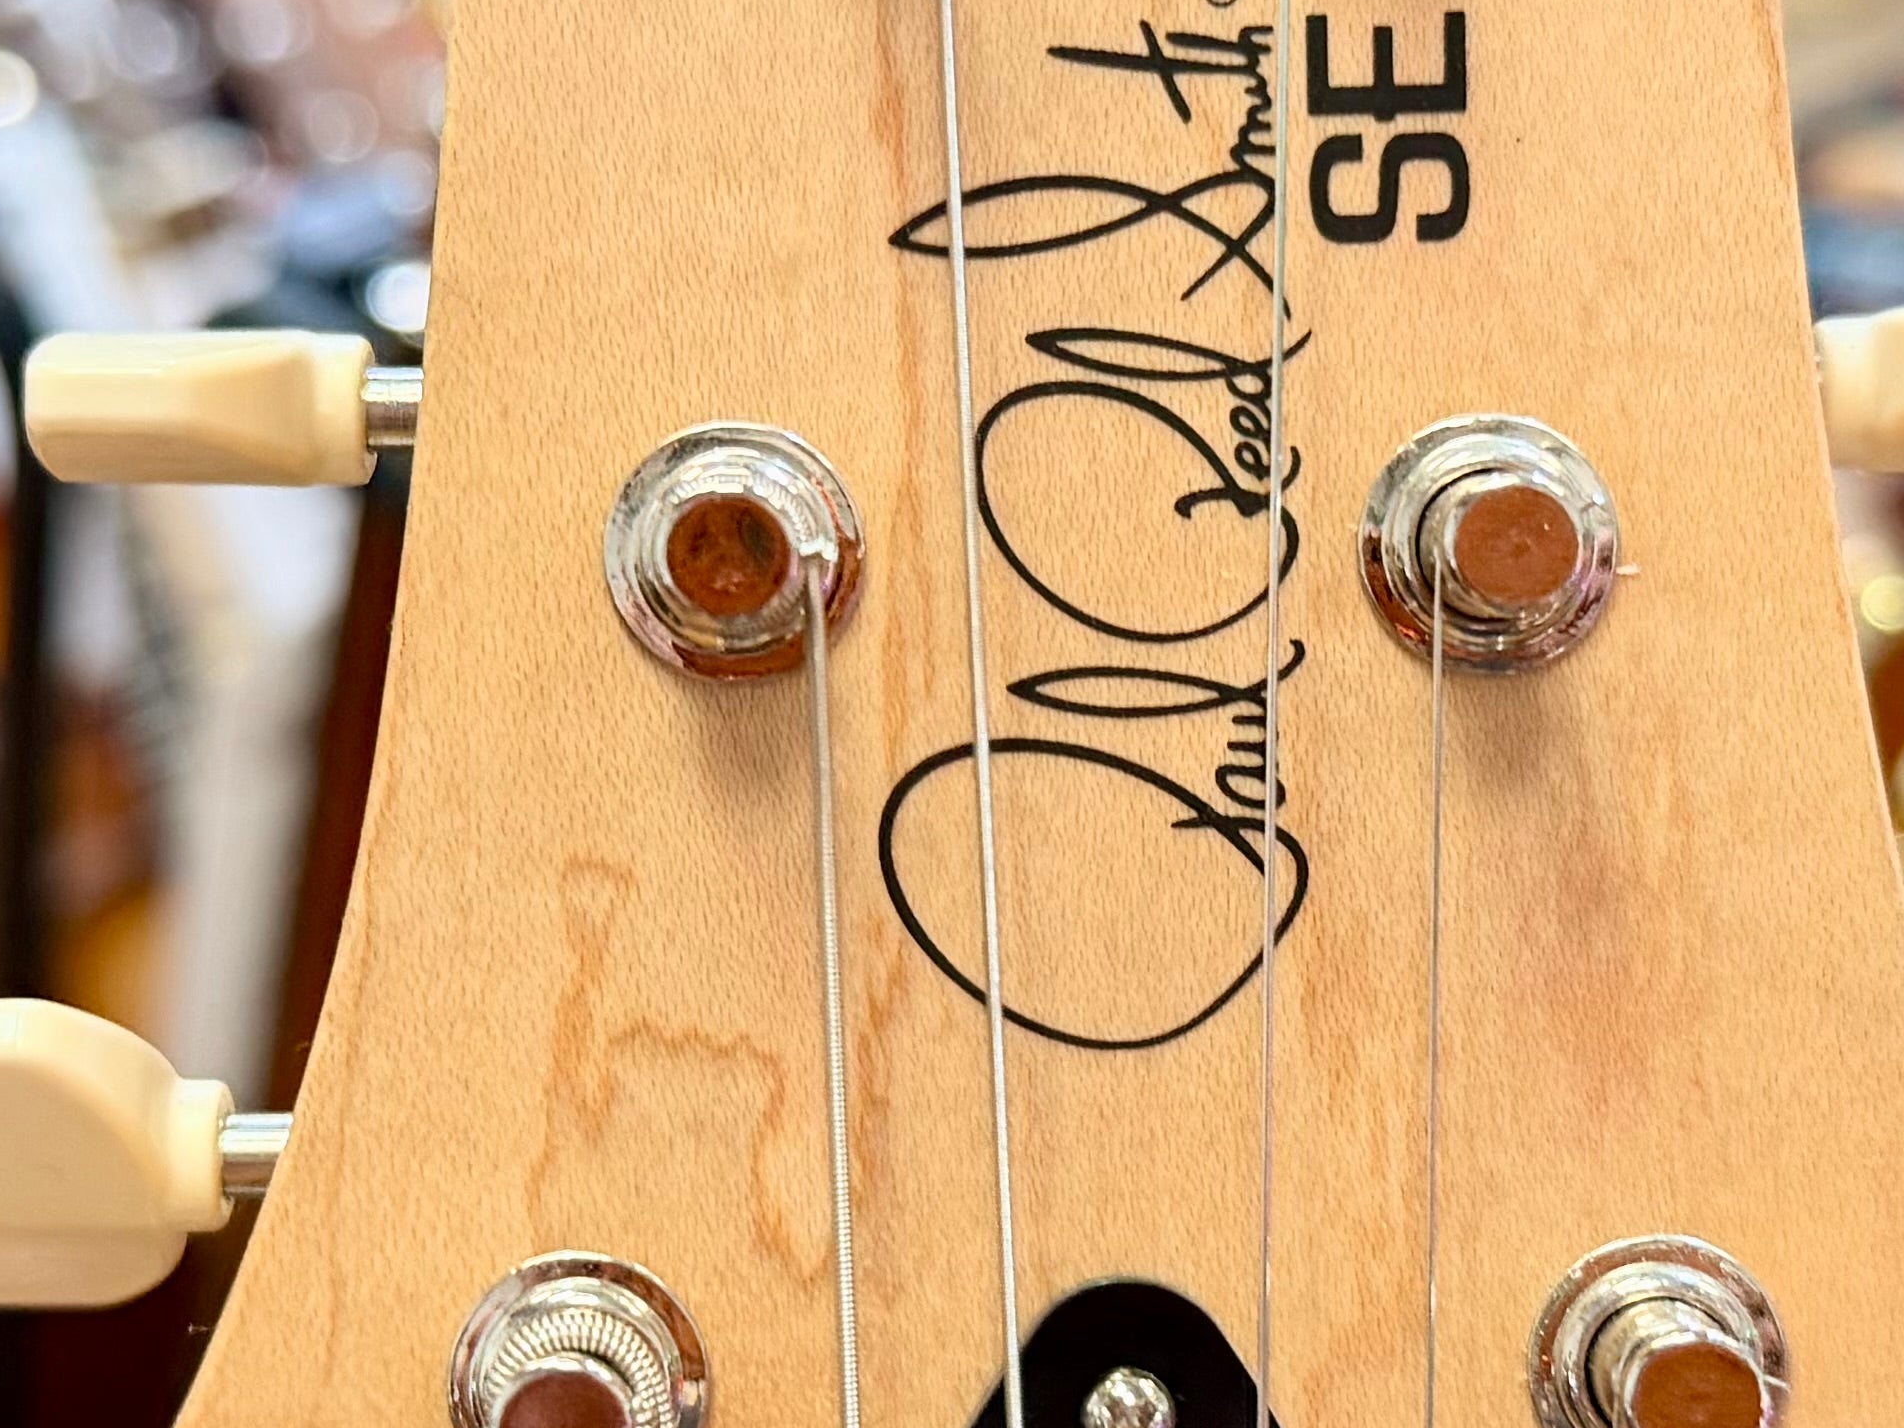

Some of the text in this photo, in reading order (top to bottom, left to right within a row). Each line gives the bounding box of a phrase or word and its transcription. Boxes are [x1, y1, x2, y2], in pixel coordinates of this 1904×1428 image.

[1305, 10, 1470, 244] SE
[974, 326, 1312, 642] Reed
[878, 638, 1310, 1050] Paul
